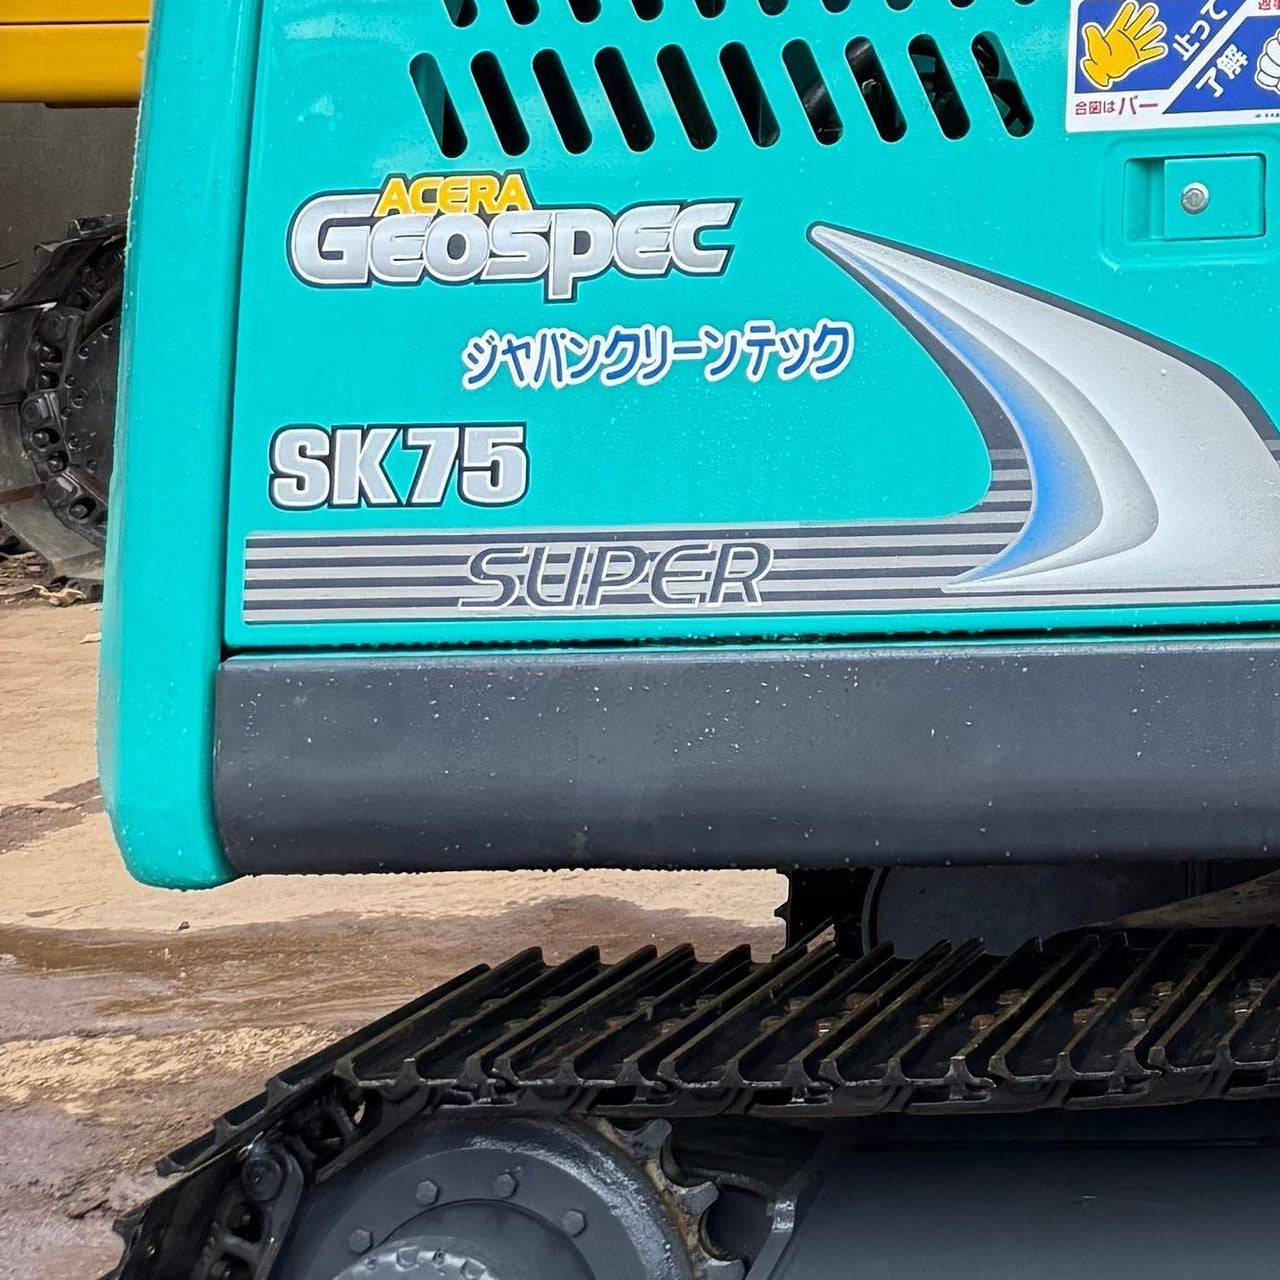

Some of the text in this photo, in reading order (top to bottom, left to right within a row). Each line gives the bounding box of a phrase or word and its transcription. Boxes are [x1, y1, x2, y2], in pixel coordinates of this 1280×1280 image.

[1194, 42, 1249, 98] 了解
[377, 173, 533, 215] ACERA
[272, 426, 528, 508] SK75
[458, 541, 776, 610] SUPER
